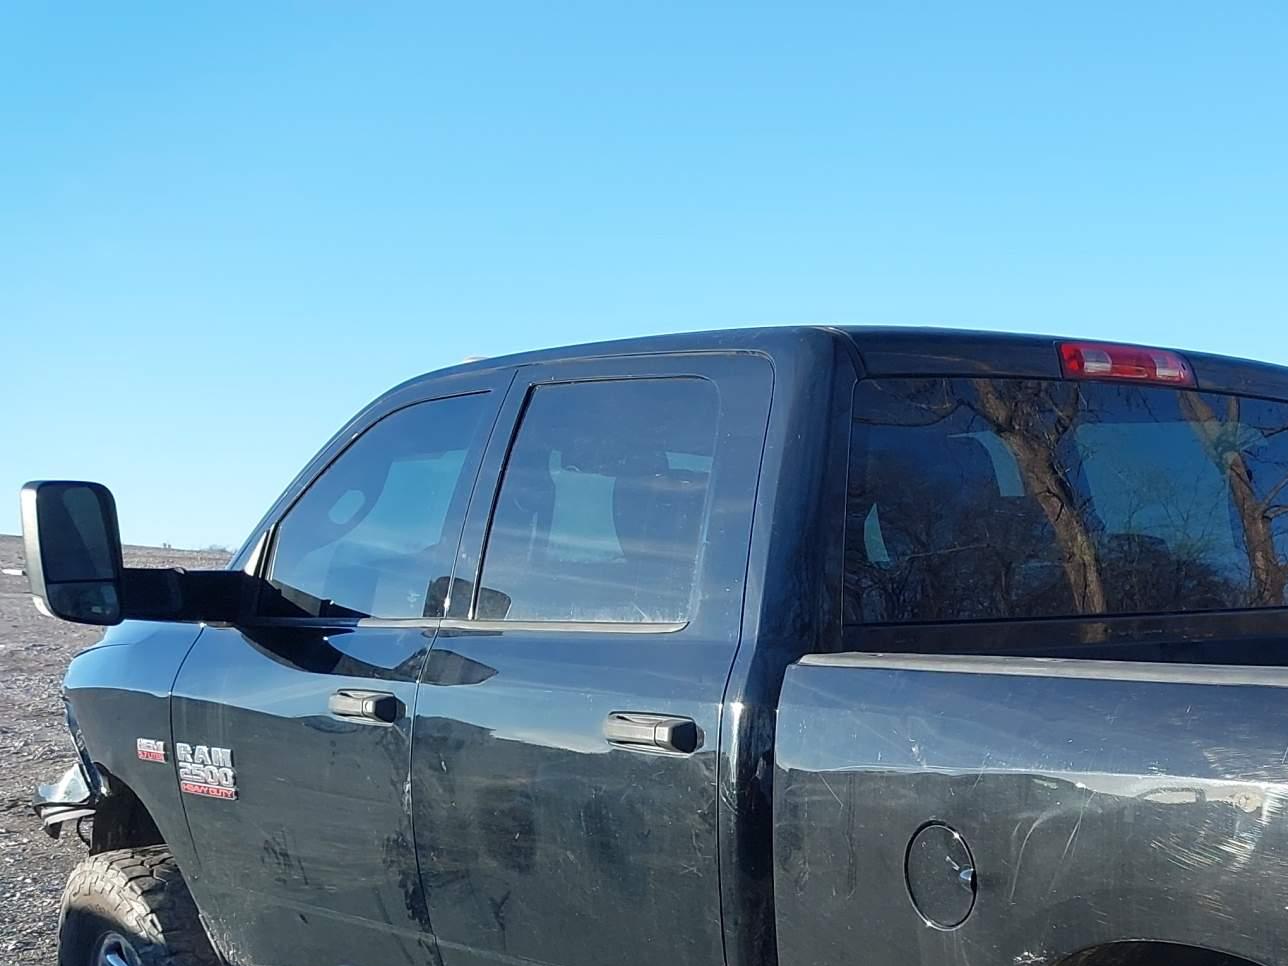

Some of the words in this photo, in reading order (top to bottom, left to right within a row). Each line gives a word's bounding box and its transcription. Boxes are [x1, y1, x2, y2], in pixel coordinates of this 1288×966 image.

[176, 742, 233, 768] RAM
[179, 762, 235, 788] 2500
[183, 782, 209, 795] HEAVY
[208, 786, 233, 799] DUTY
